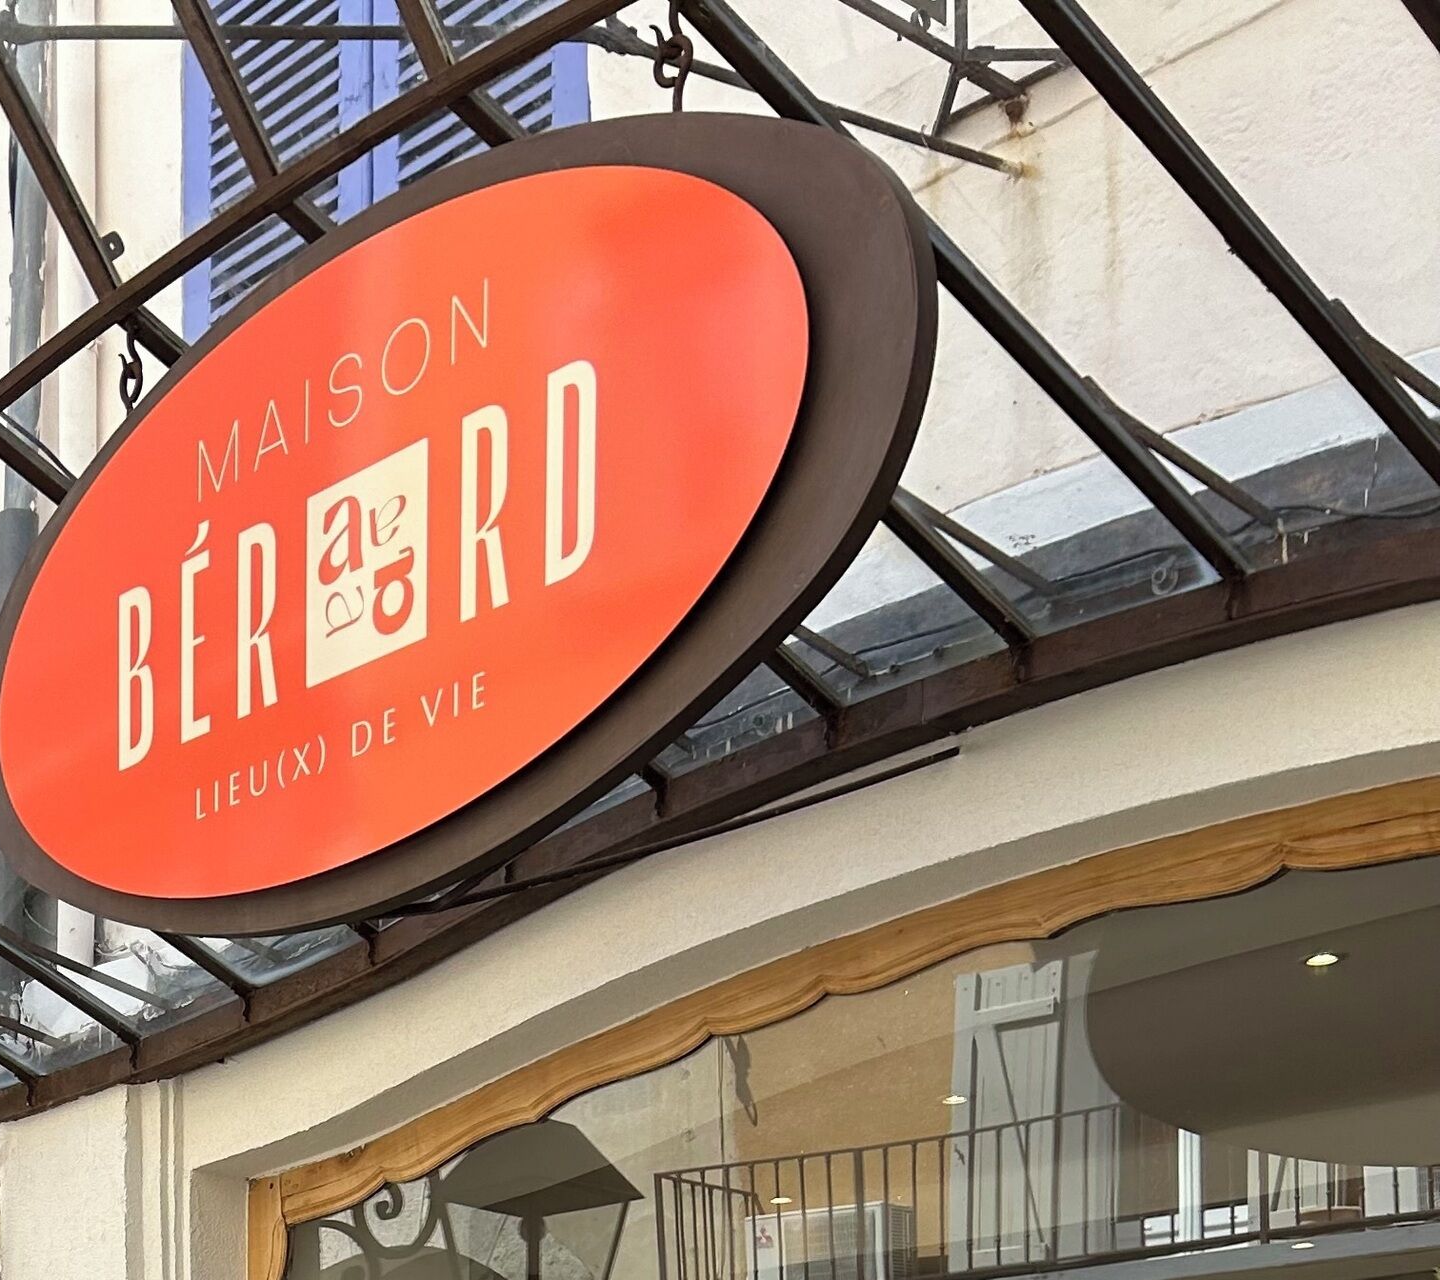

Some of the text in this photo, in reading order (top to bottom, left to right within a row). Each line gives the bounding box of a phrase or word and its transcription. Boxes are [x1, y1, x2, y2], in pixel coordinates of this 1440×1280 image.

[196, 277, 491, 503] MAISON
[195, 670, 489, 821] LIEU(X) DE VIE
